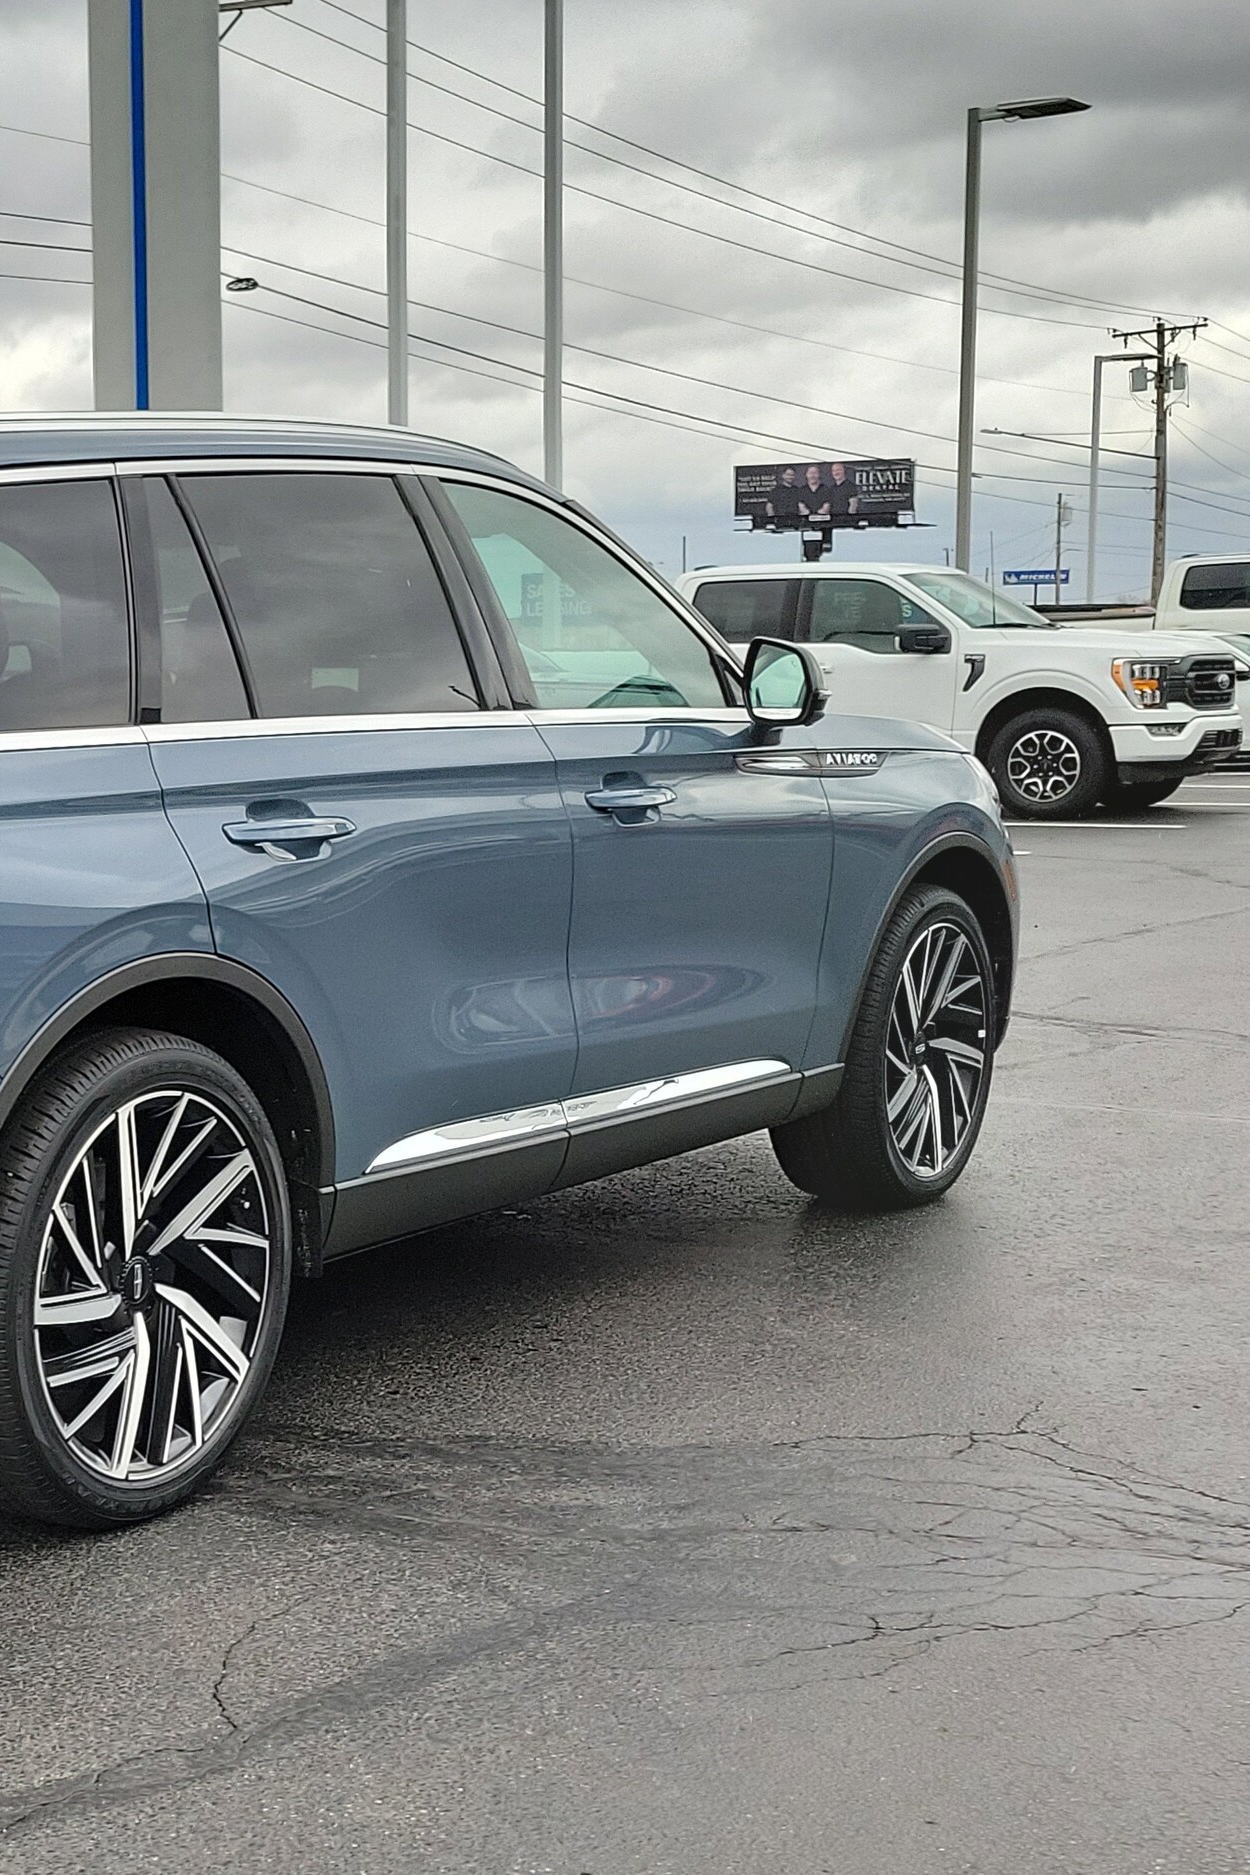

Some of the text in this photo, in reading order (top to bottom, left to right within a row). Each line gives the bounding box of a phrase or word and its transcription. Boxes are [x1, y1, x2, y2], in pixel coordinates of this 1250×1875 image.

[855, 470, 911, 485] ELEVATE
[862, 484, 900, 492] DENTAL
[826, 753, 878, 765] AVIATOR
